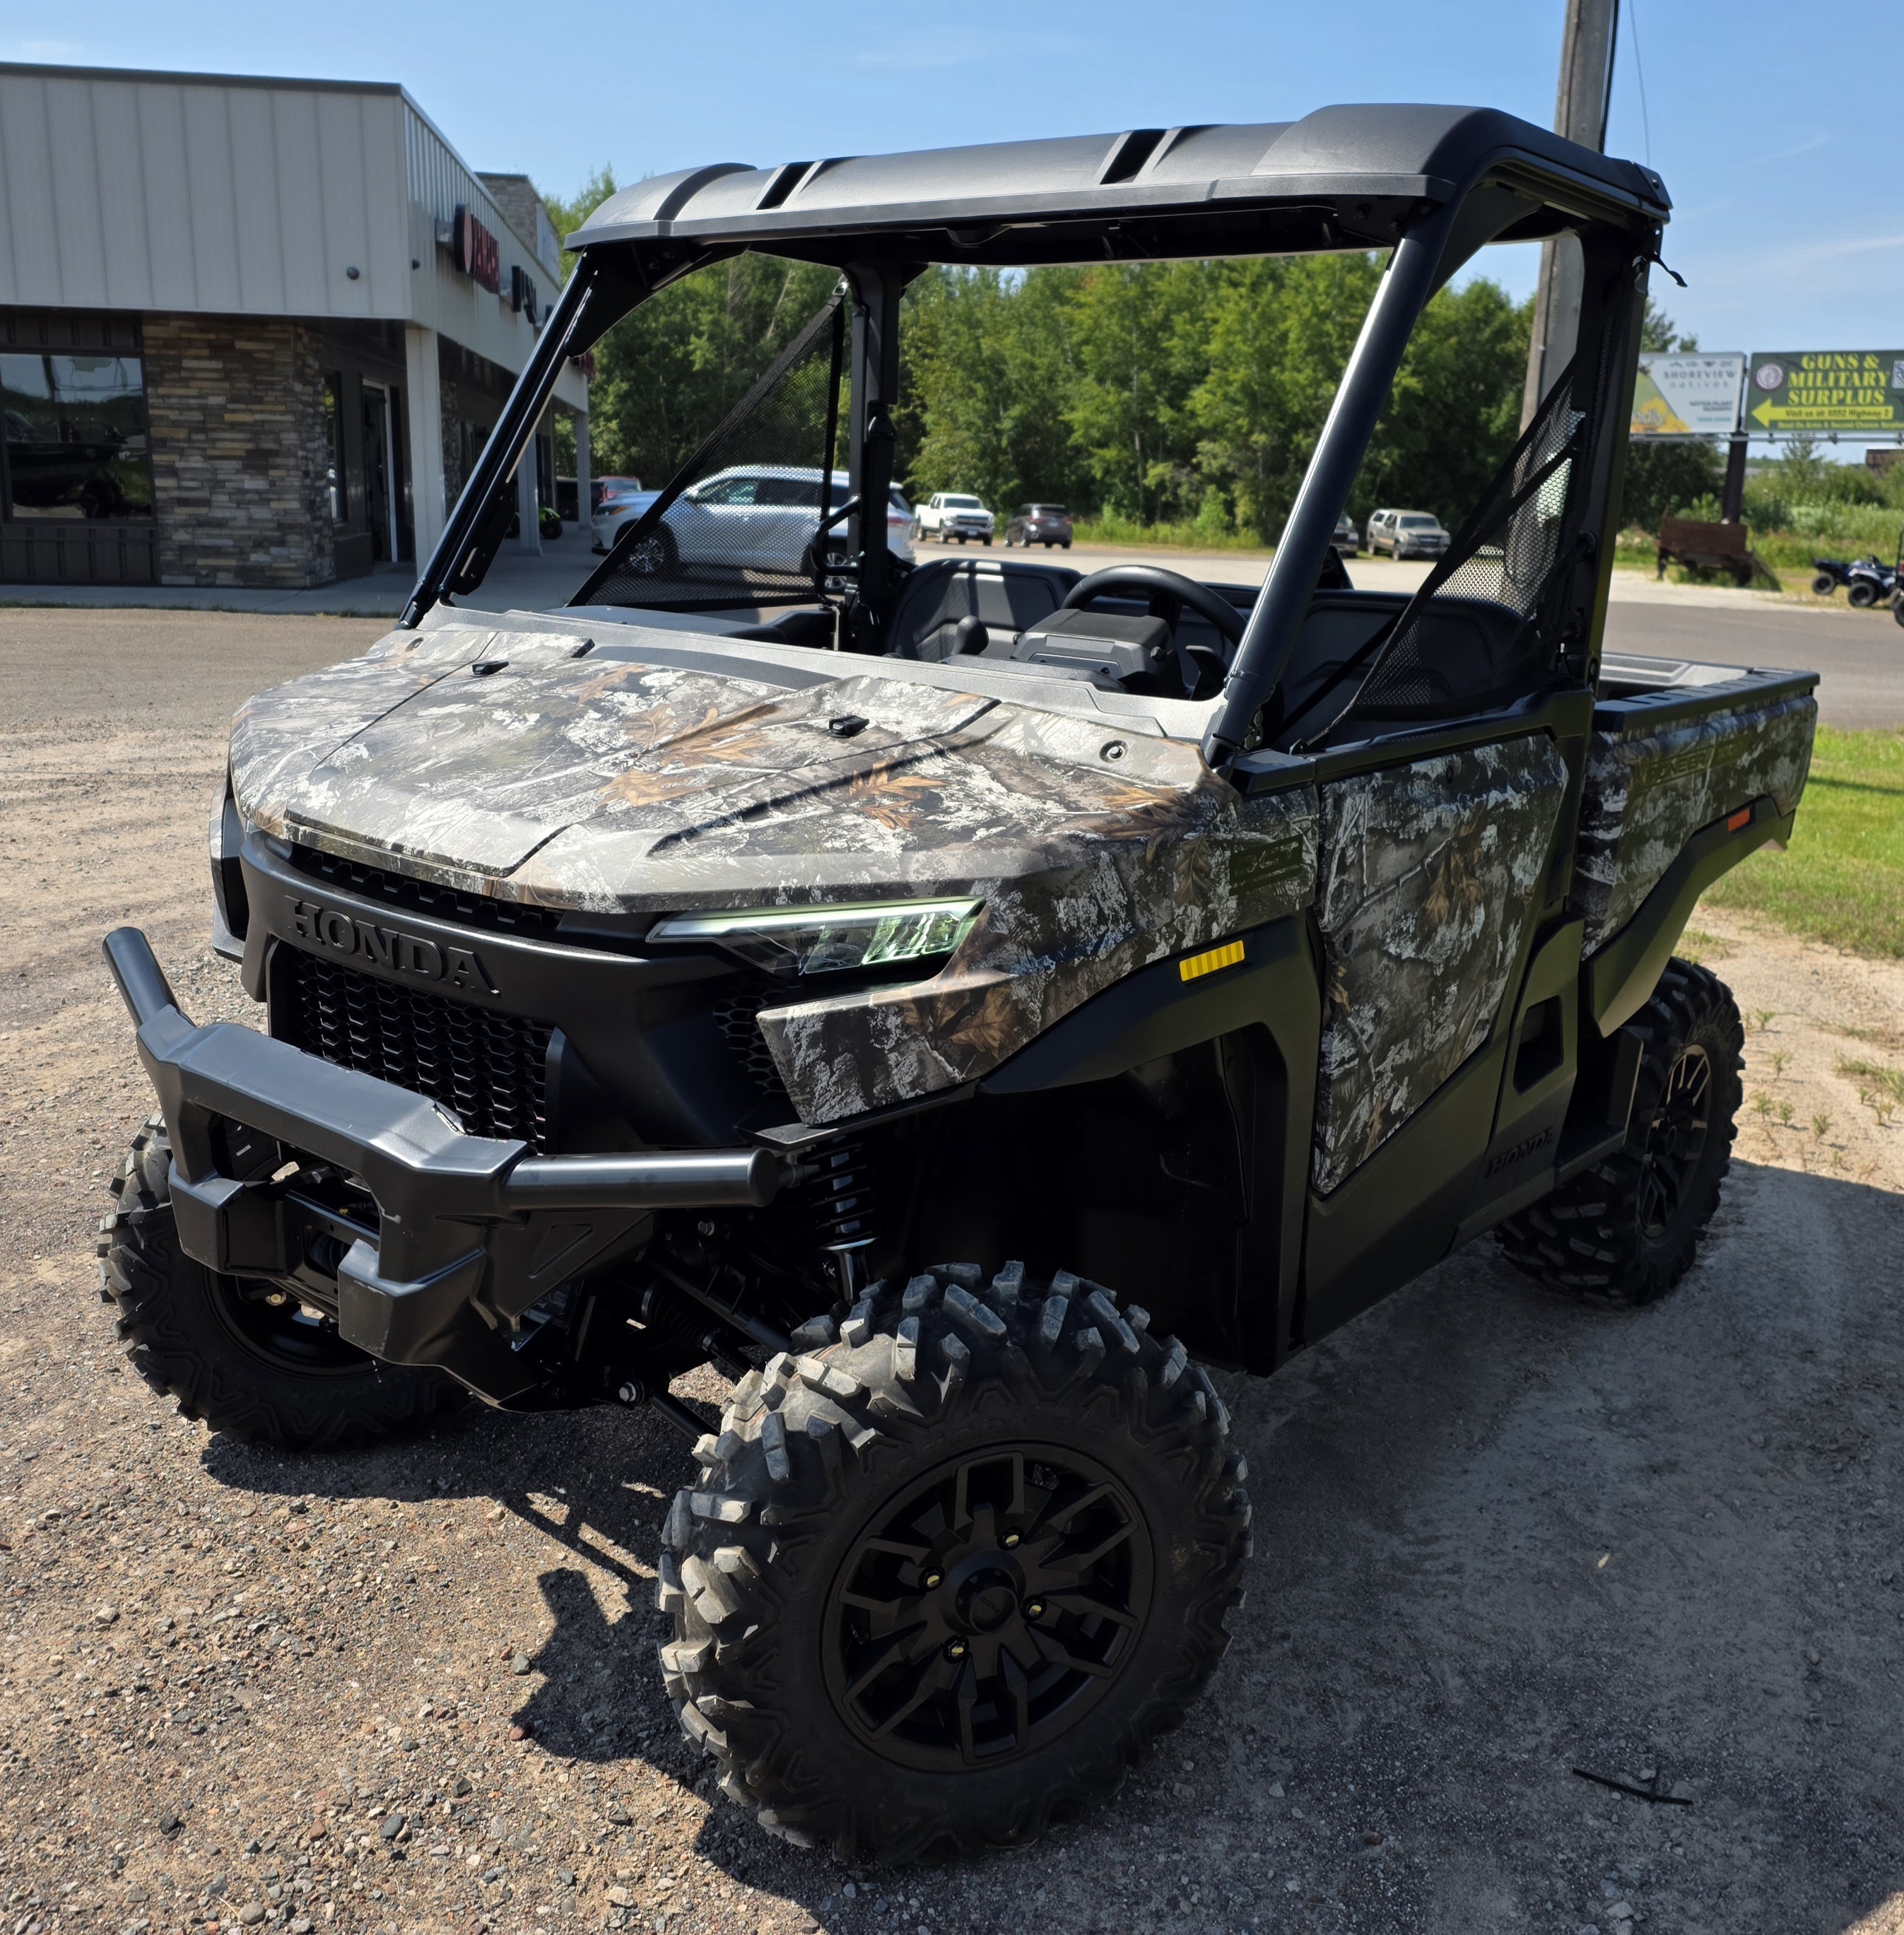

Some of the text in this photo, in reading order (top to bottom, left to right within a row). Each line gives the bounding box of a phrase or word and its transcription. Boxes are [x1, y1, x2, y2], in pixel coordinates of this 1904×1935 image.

[1802, 353, 1880, 370] GUNS &
[1663, 370, 1736, 380] SHOREVIEW
[1788, 371, 1891, 388] MILITARY
[1788, 389, 1886, 406] SURPLUS
[284, 895, 502, 997] HONDA
[1484, 1125, 1553, 1180] HONDA
